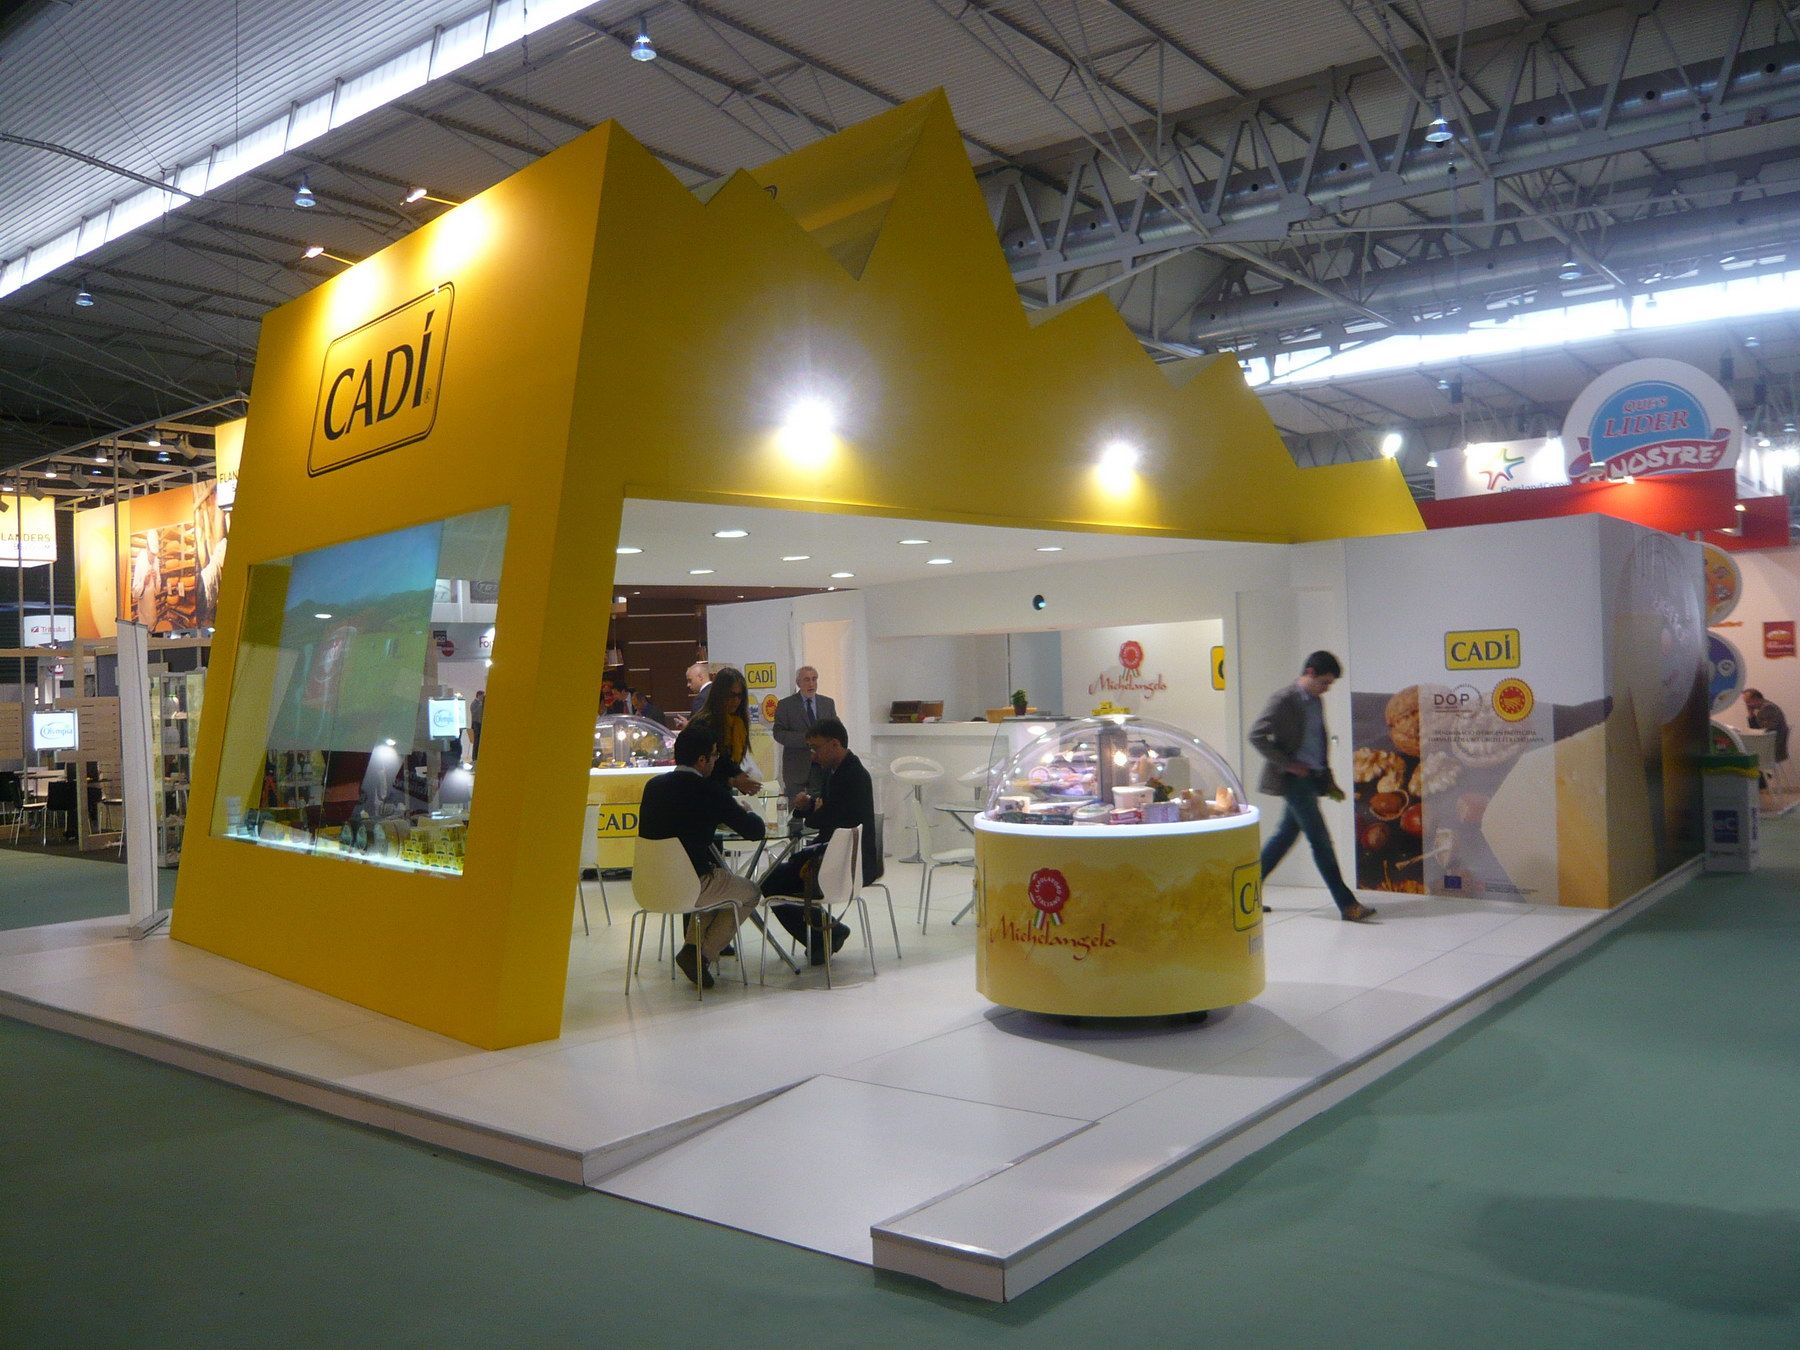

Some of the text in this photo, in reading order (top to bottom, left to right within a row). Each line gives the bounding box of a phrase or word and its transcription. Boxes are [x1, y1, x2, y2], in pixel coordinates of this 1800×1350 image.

[324, 309, 435, 441] CADÍ
[1603, 409, 1690, 439] LIDER
[1450, 633, 1512, 662] CADÍ
[747, 665, 774, 684] CADÍ
[1088, 673, 1167, 699] Michelangelo
[1434, 693, 1471, 707] DOP
[990, 914, 1117, 961] Michelangelo
